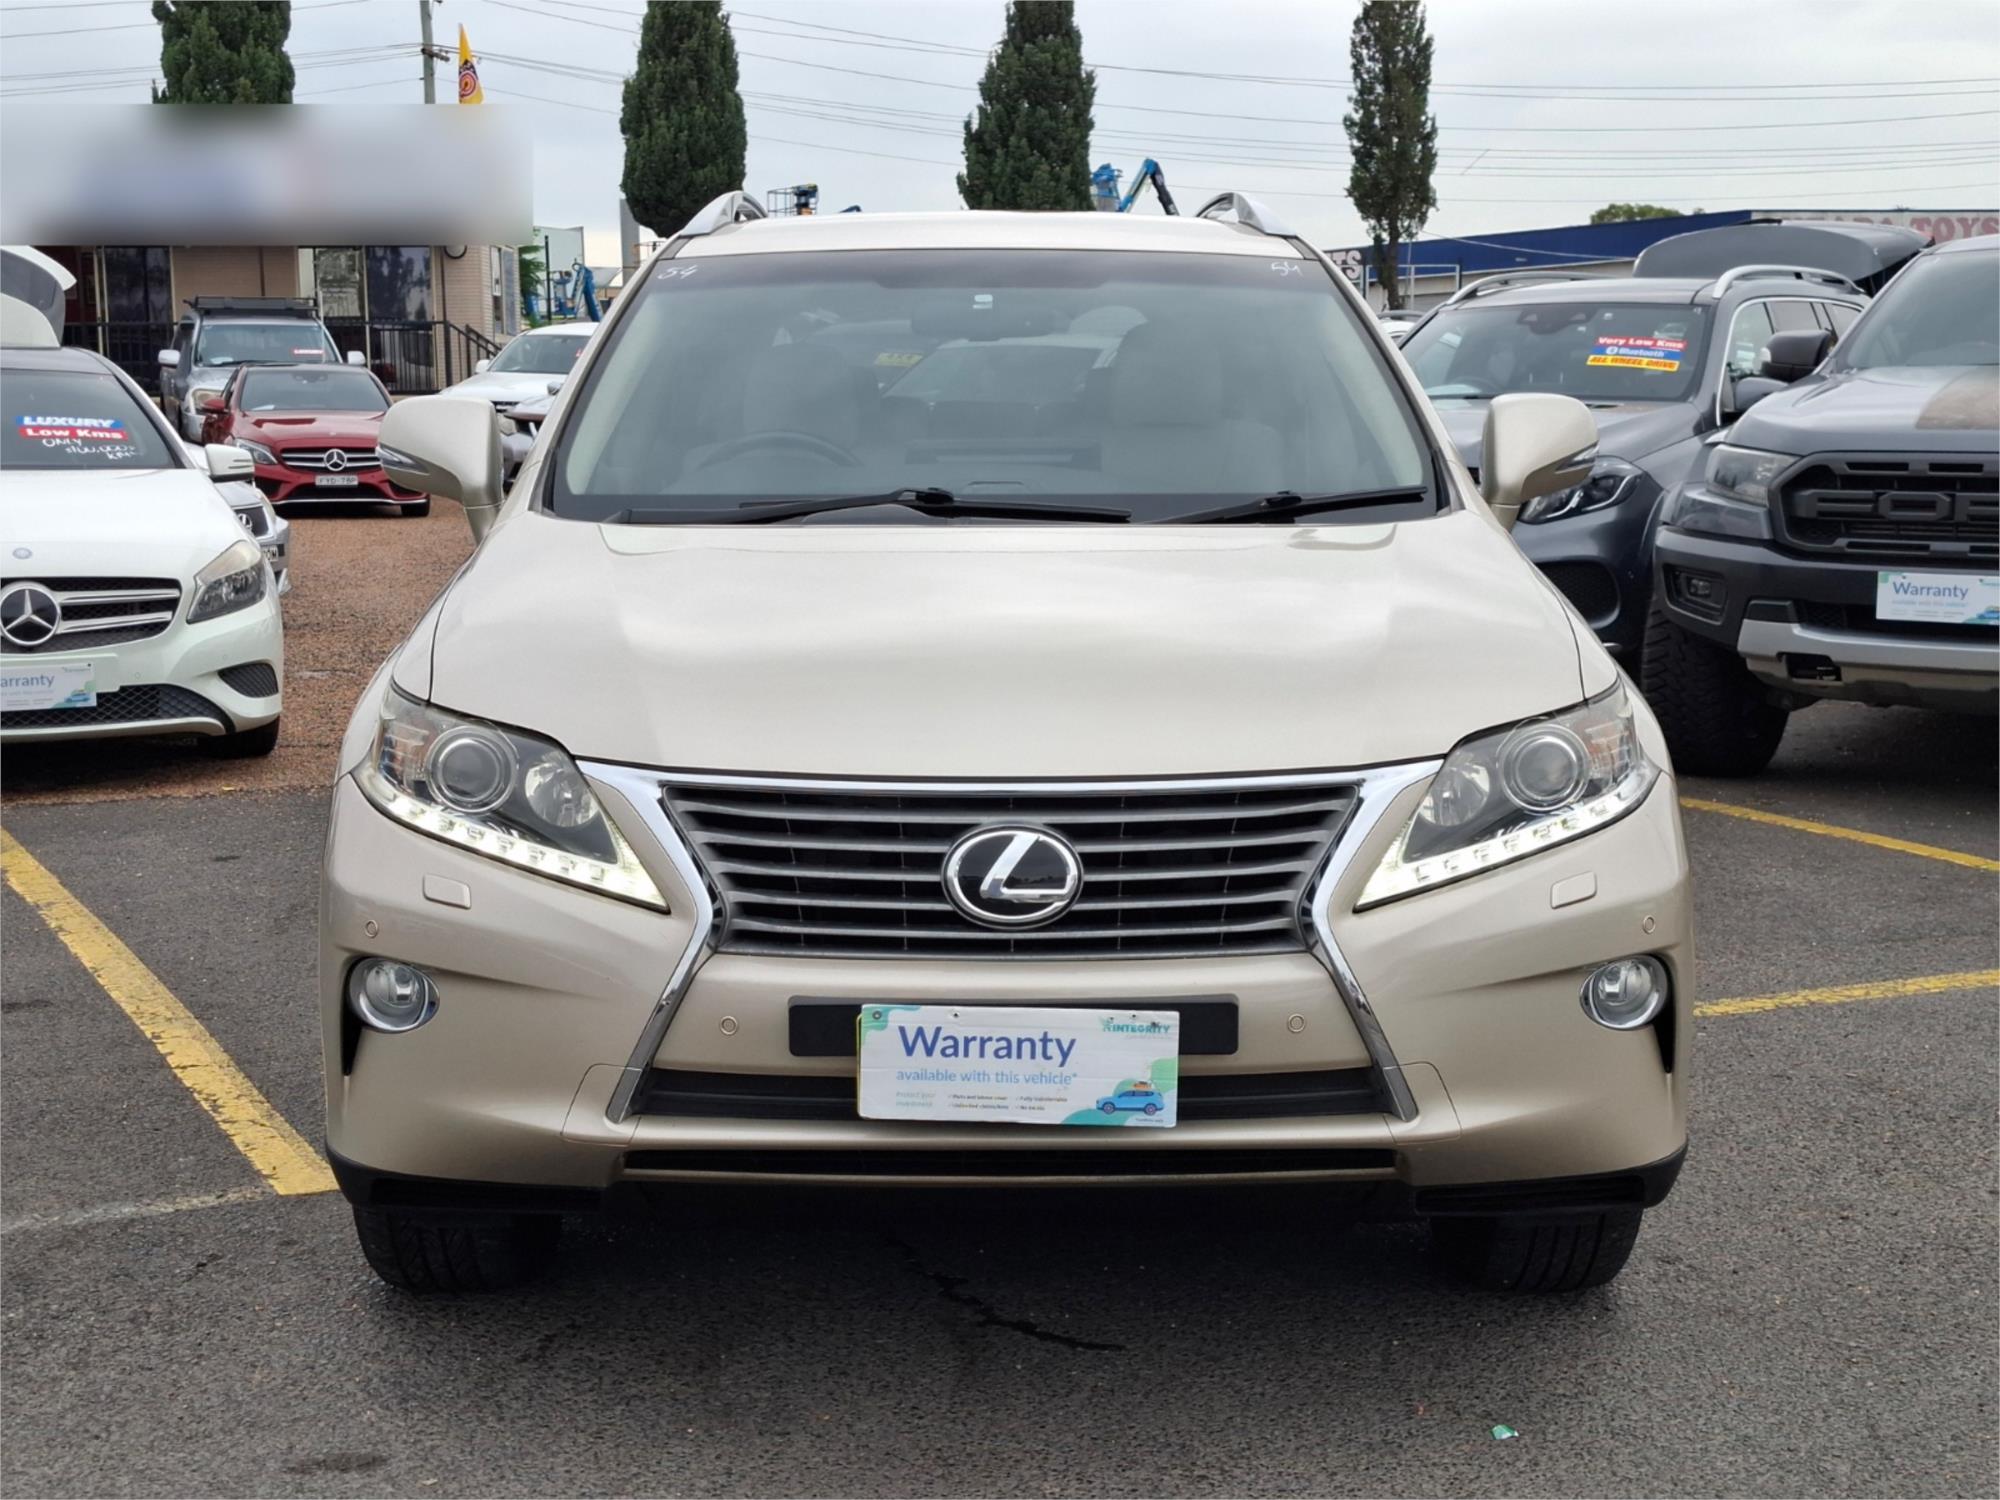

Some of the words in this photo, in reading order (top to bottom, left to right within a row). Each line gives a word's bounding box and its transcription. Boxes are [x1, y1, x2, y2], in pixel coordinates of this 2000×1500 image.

[1598, 337, 1626, 346] Very
[1628, 338, 1654, 347] Low
[23, 416, 115, 428] LUXURY
[26, 428, 70, 437] Low
[75, 429, 123, 439] Kms
[1893, 581, 1969, 600] Warranty
[0, 675, 55, 688] arranty
[1113, 1023, 1171, 1033] INTEGRITY
[898, 1025, 1077, 1068] Warranty
[896, 1068, 957, 1082] available
[960, 1070, 991, 1083] with
[995, 1071, 1020, 1084] this
